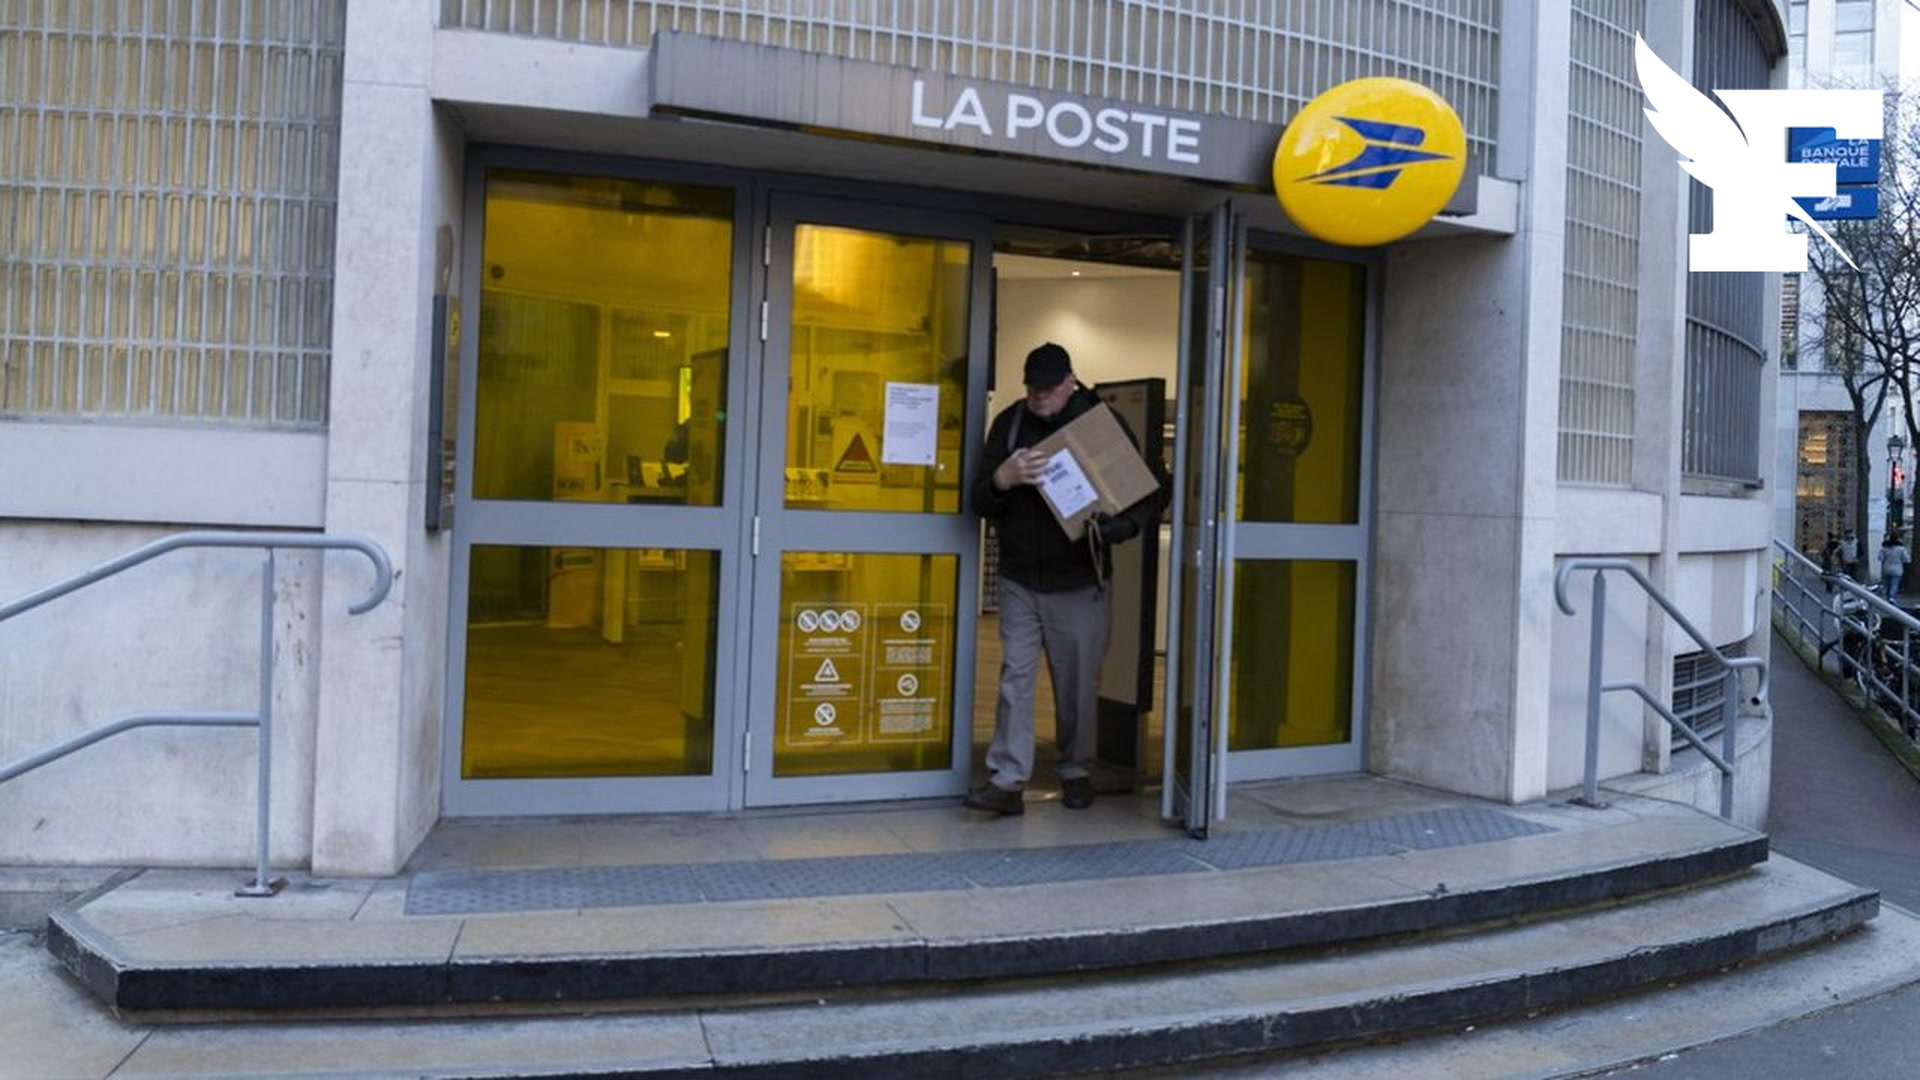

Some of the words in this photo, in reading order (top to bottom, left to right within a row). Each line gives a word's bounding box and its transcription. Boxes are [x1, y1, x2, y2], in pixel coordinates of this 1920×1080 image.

[912, 80, 992, 135] LA
[1007, 94, 1200, 163] POSTE
[1801, 147, 1869, 157] BANQUE
